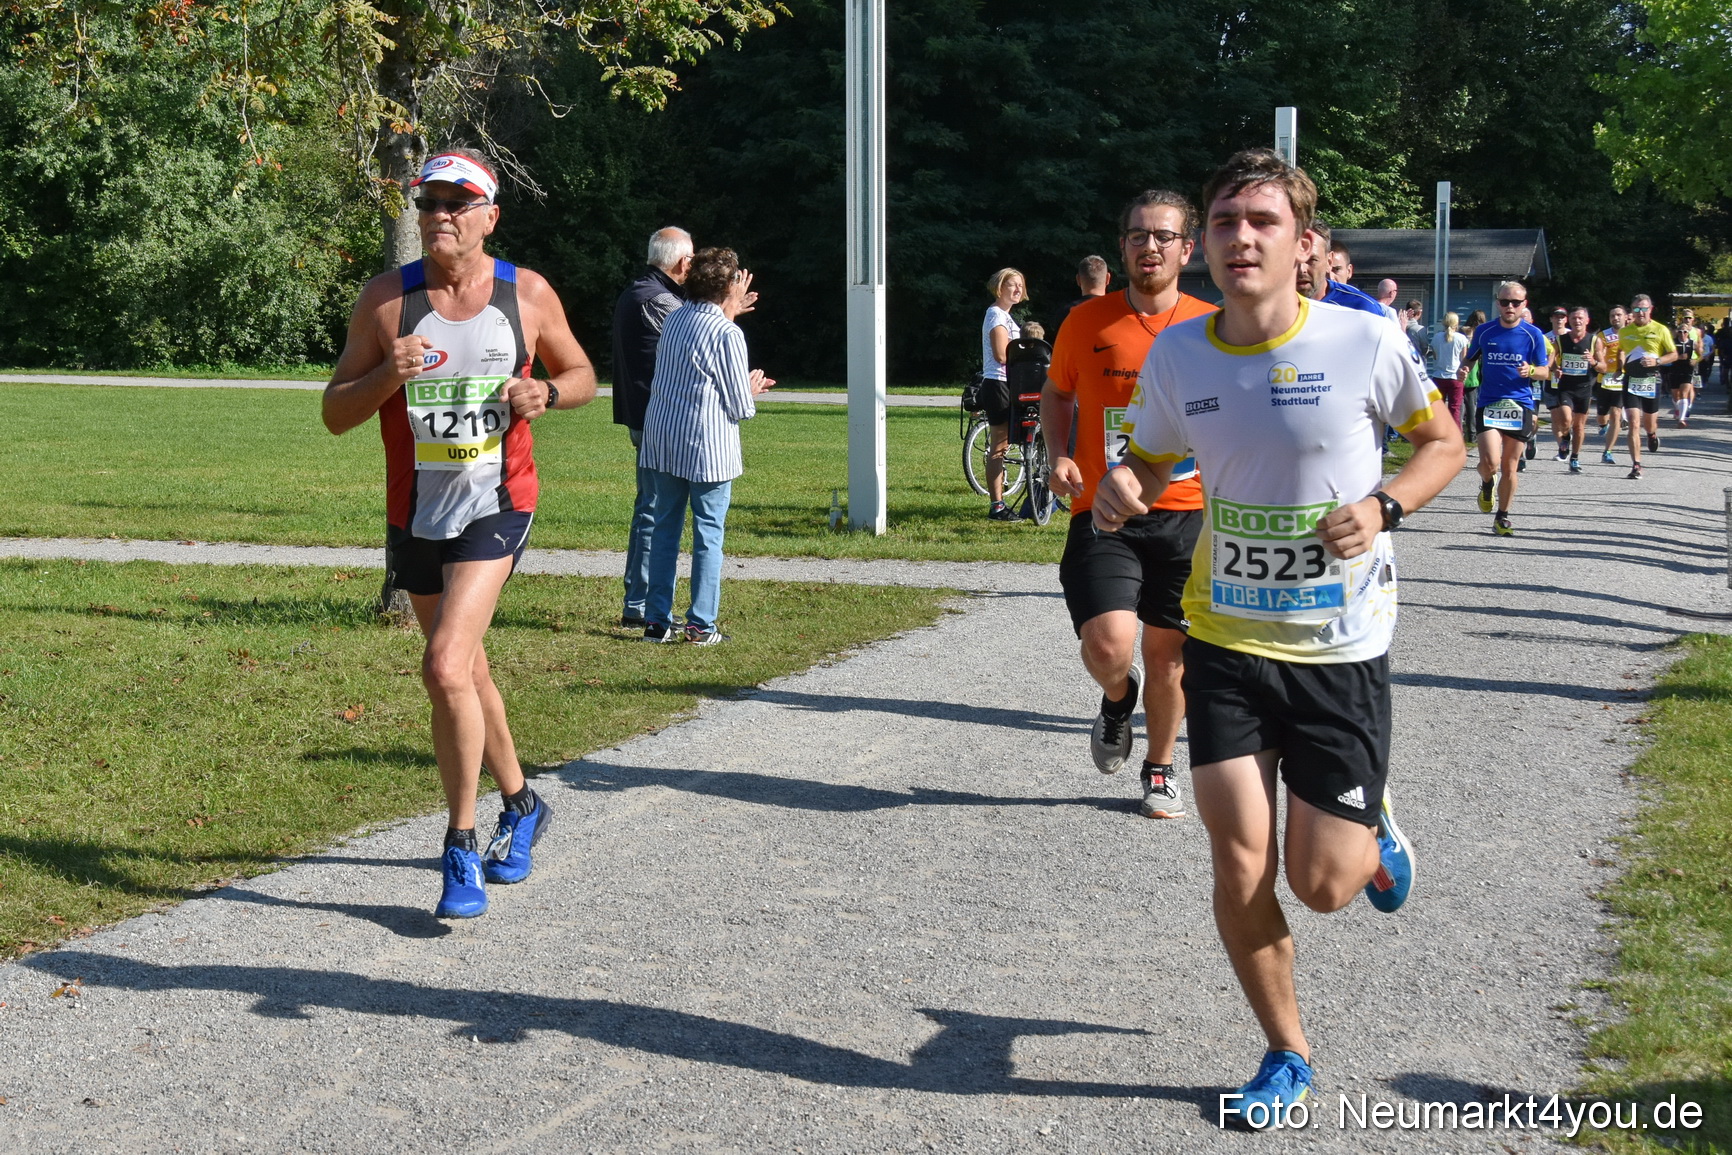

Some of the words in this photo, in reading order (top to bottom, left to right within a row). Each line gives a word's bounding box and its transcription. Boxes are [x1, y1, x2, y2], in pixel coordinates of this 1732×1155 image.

[423, 354, 439, 364] kn
[1488, 352, 1523, 361] SYSCAD
[1564, 361, 1585, 369] 2130
[1103, 368, 1111, 377] It
[1112, 368, 1139, 379] migh
[1271, 367, 1297, 384] 20
[416, 381, 500, 402] BOCK
[1271, 384, 1332, 395] Neumarkter
[1631, 384, 1652, 392] 2226
[1186, 397, 1219, 412] BOCK
[1271, 395, 1321, 407] Stadtlauf
[1488, 409, 1519, 419] 2140
[421, 409, 500, 438] 1210
[448, 447, 479, 460] UDO
[1220, 504, 1325, 534] BOCK
[1223, 541, 1326, 581] 2523
